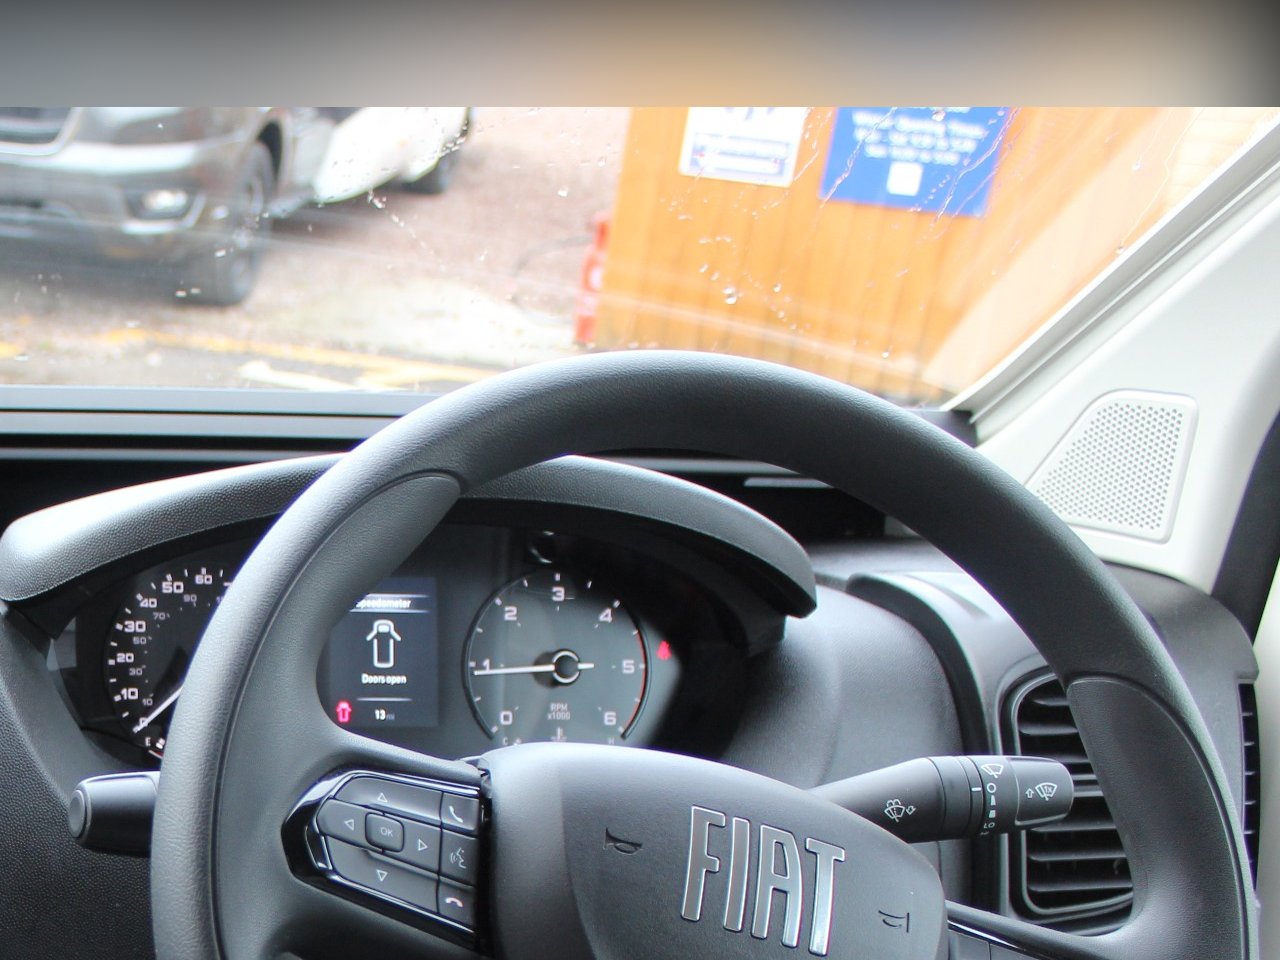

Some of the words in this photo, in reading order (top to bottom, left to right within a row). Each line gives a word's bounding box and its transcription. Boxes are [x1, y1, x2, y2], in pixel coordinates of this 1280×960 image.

[195, 574, 213, 584] 60
[162, 581, 184, 593] 50
[551, 586, 565, 601] 3
[139, 597, 158, 608] 40
[504, 606, 517, 621] 2
[598, 608, 613, 623] 4
[124, 620, 146, 632] 30
[116, 652, 134, 663] 20
[482, 658, 491, 672] 1
[622, 659, 635, 674] 5
[361, 673, 385, 684] Doors
[385, 675, 407, 686] open
[120, 687, 138, 700] 10
[550, 703, 568, 711] RPM
[375, 709, 386, 720] 13
[500, 710, 513, 725] 0
[547, 711, 570, 720] x1000
[604, 712, 617, 726] 6
[145, 737, 151, 746] E
[380, 826, 394, 837] OK
[679, 804, 846, 957] FIAT
